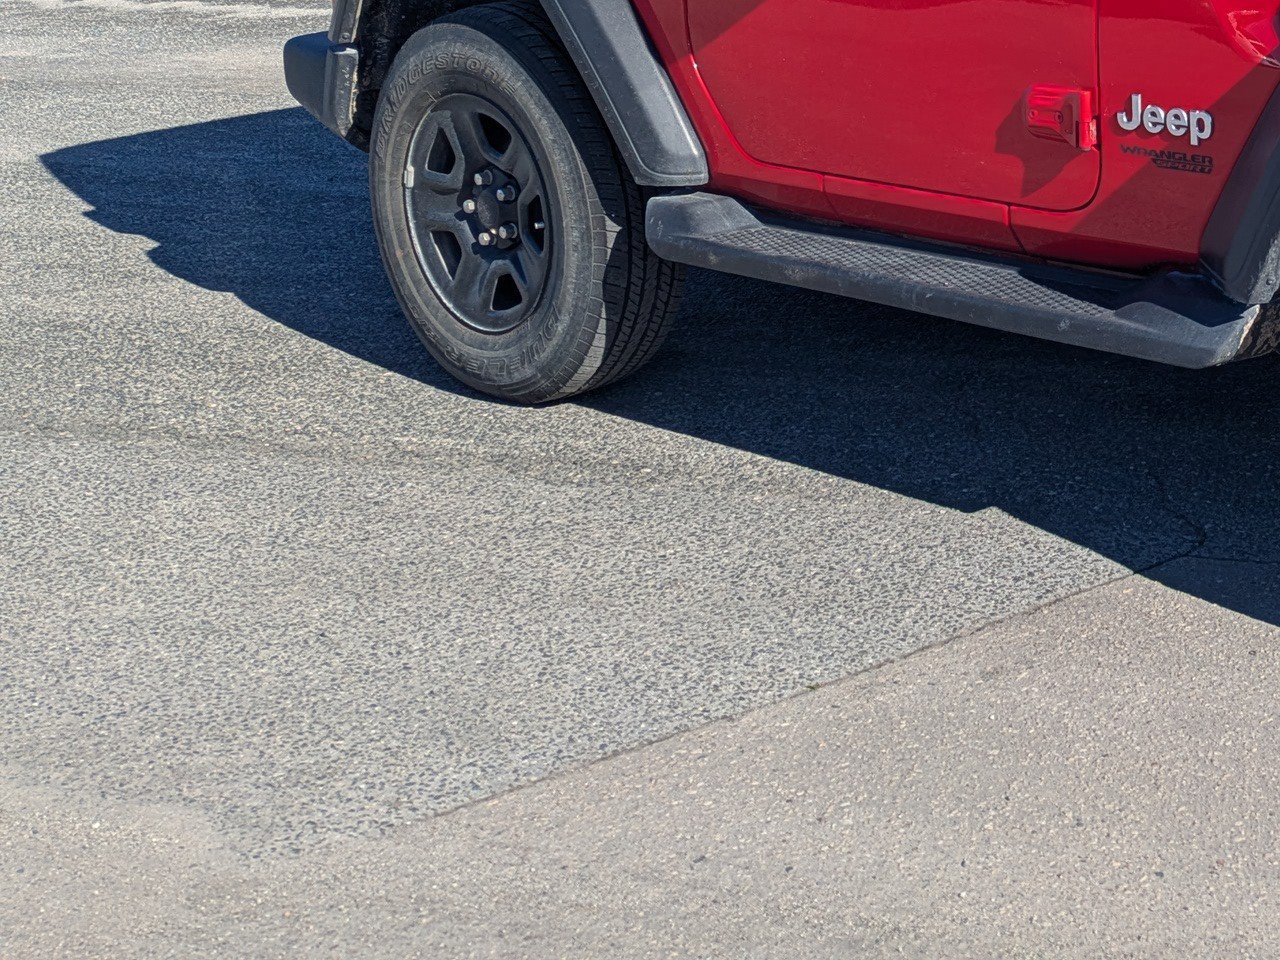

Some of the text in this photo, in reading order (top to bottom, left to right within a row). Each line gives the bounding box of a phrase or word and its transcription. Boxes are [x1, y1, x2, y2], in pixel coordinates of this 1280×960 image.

[376, 51, 518, 159] BRIDGESTONE
[1116, 93, 1213, 146] Jeep
[1120, 145, 1213, 166] WRANGLER
[1155, 159, 1212, 174] SPORT
